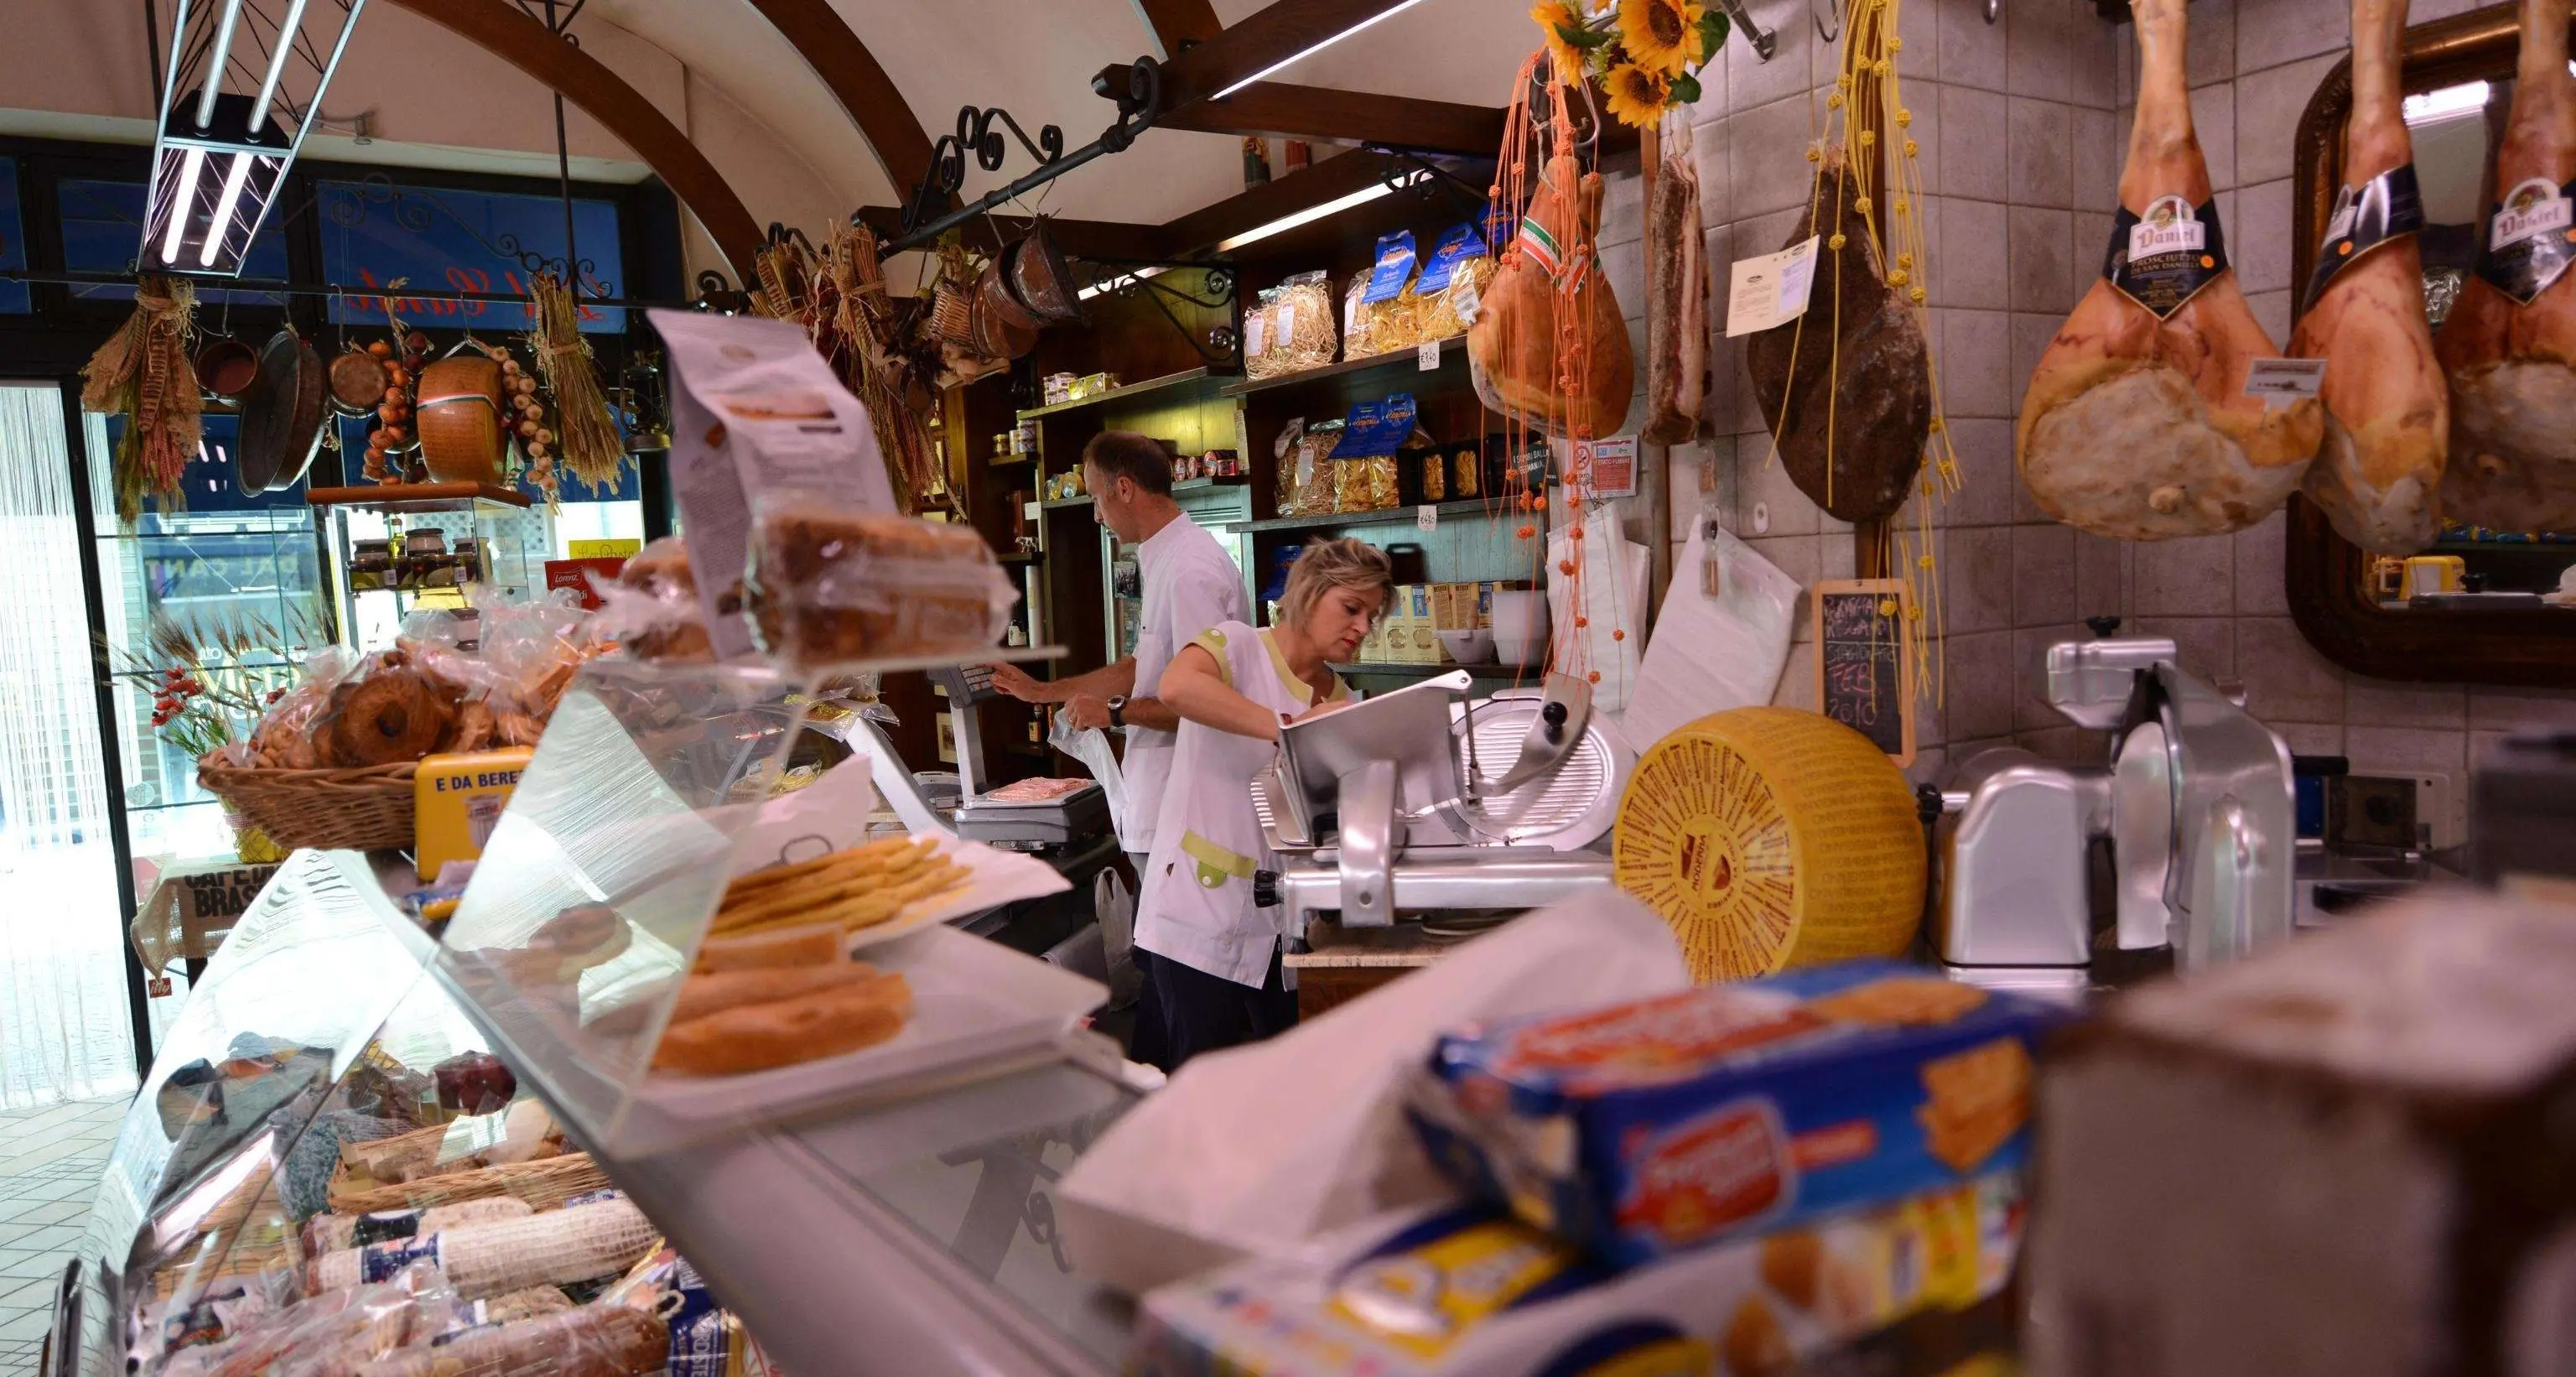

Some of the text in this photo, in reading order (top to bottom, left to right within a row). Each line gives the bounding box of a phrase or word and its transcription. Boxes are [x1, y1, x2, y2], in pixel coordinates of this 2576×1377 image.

[554, 574, 579, 583] Lorenz
[1828, 697, 1877, 727] 2010
[435, 767, 523, 792] E DA BERE
[194, 883, 267, 917] BRAS
[149, 982, 170, 996] illy
